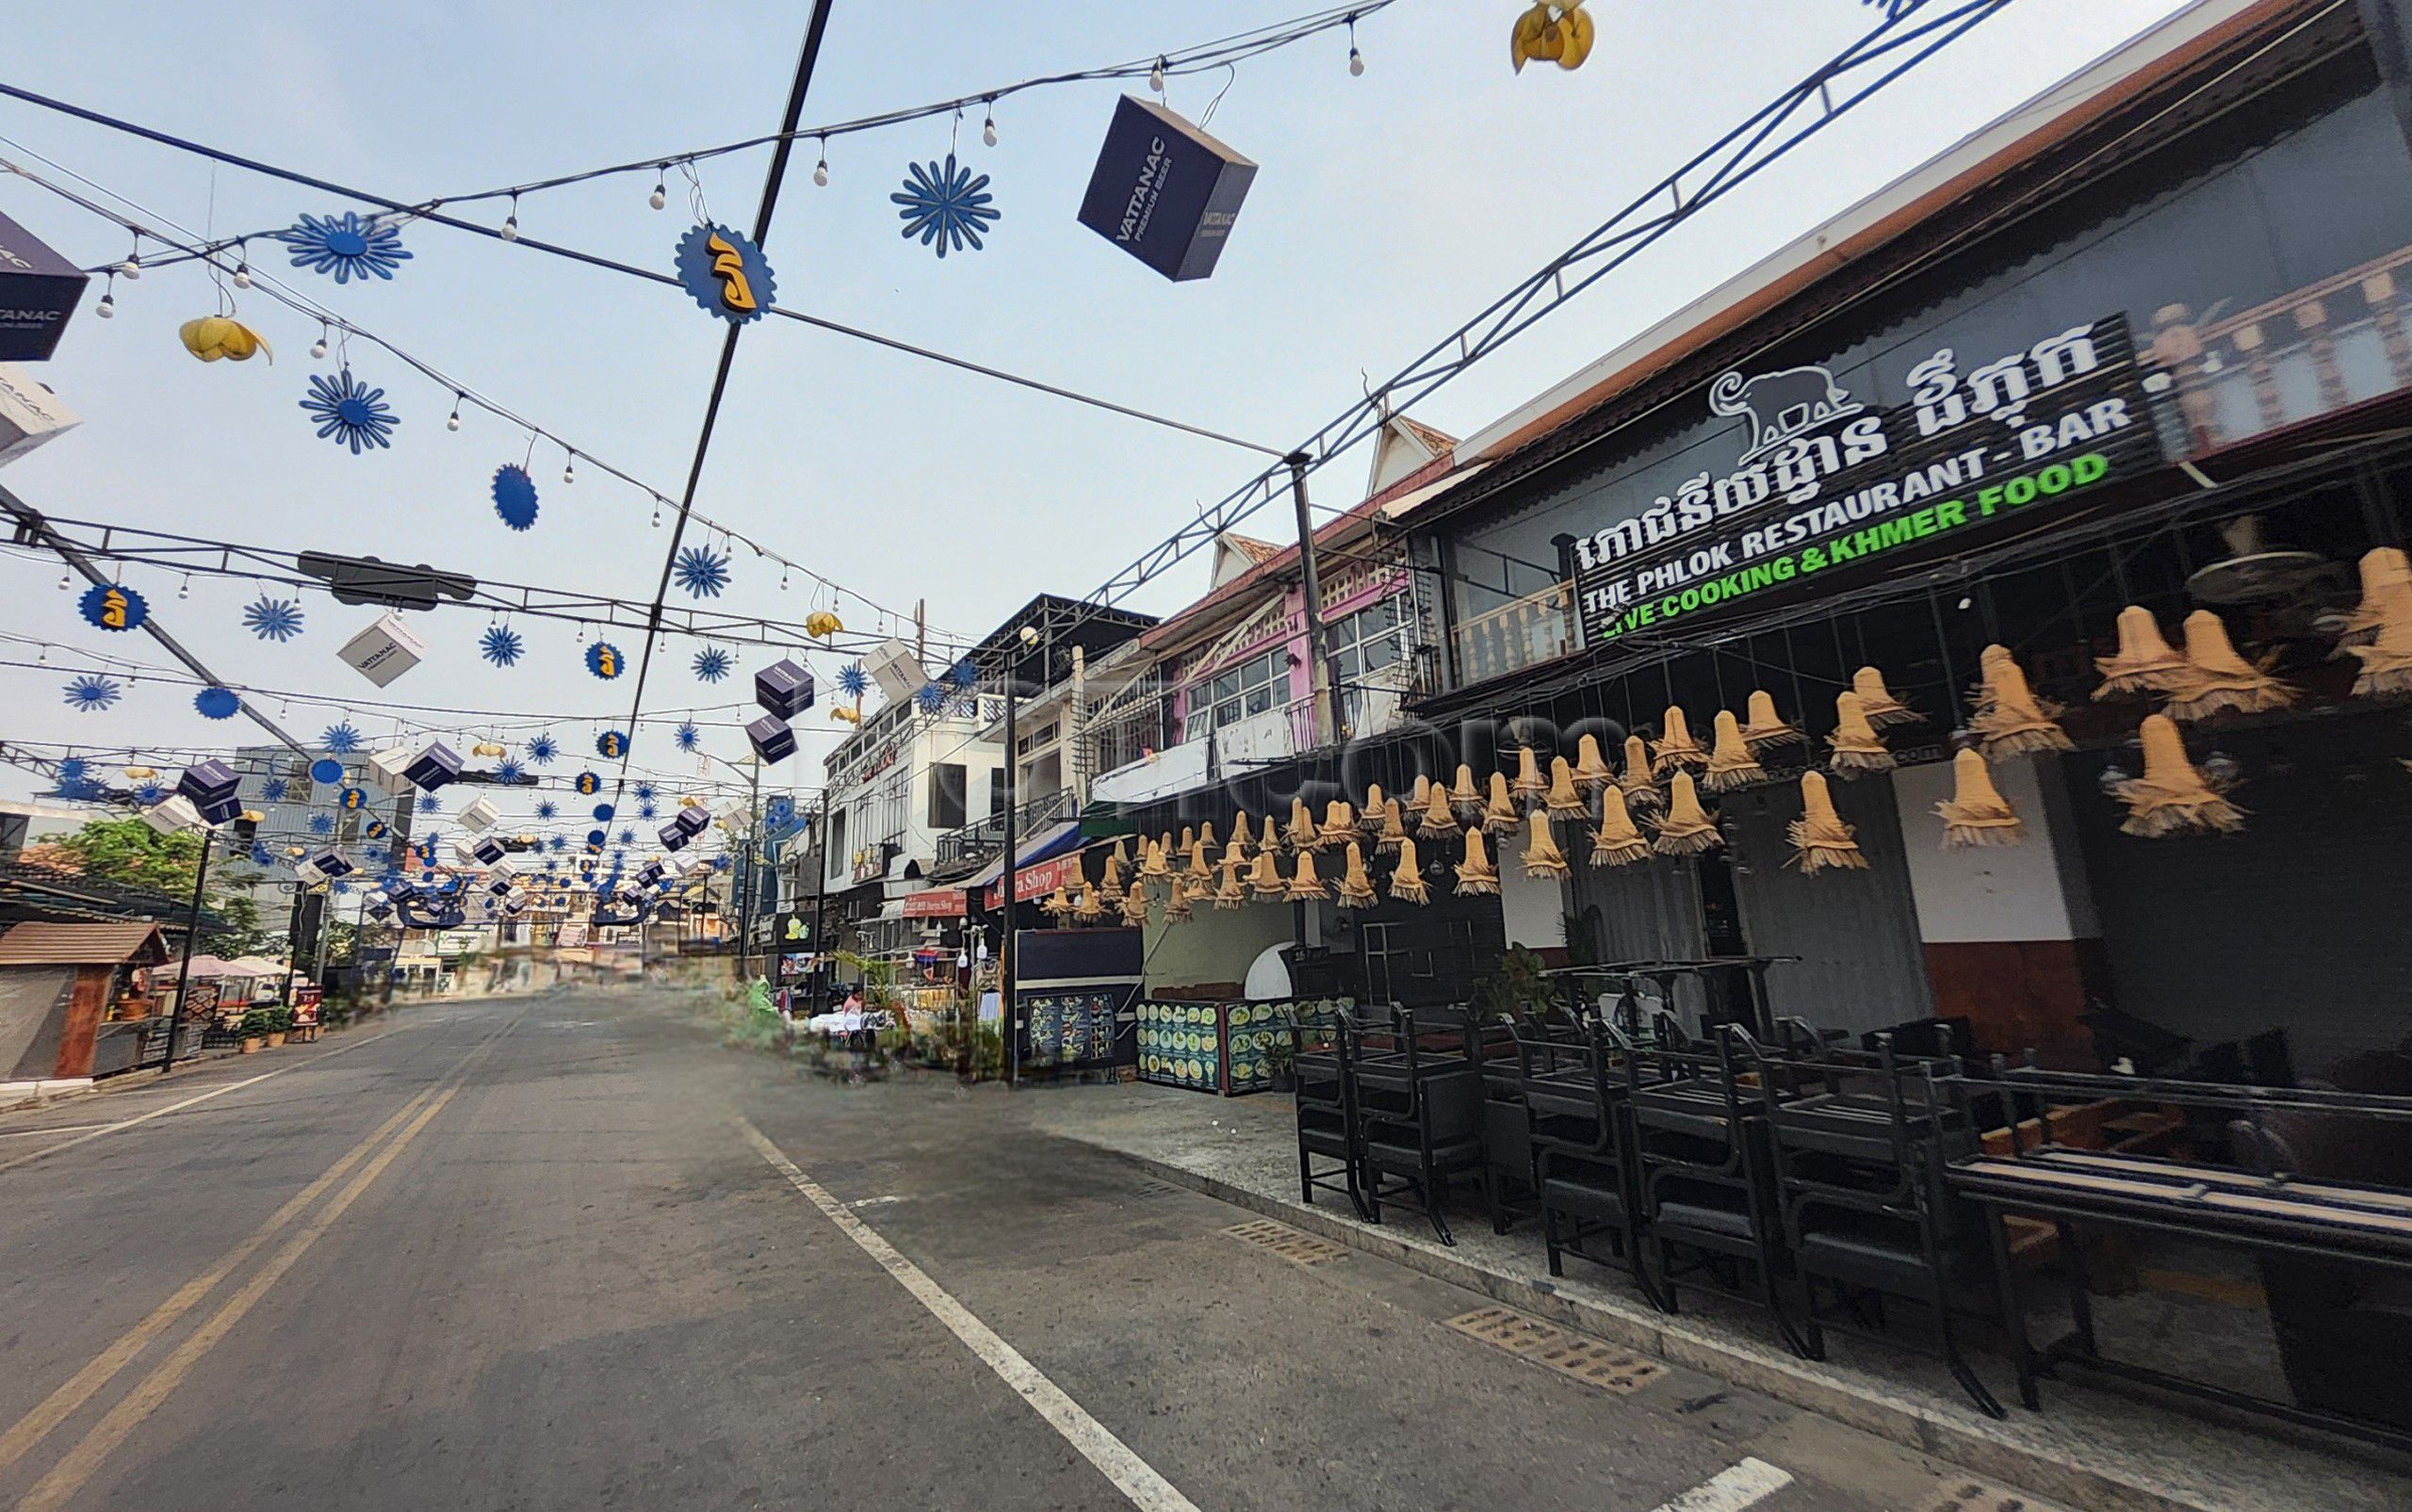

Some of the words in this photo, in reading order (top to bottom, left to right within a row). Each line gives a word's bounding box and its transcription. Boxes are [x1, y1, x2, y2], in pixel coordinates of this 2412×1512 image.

[1116, 136, 1165, 241] VATTANAC
[1134, 189, 1159, 242] PREMIUM
[1582, 578, 1632, 613] THE
[1637, 541, 1735, 596] PHLOK
[1741, 447, 1990, 560] RESTAURANT
[2019, 397, 2132, 461] BAR
[1661, 556, 1796, 618] COOKING
[1829, 500, 1968, 565] KHMER
[1978, 452, 2110, 517] FOOD
[1026, 869, 1053, 891] Shop
